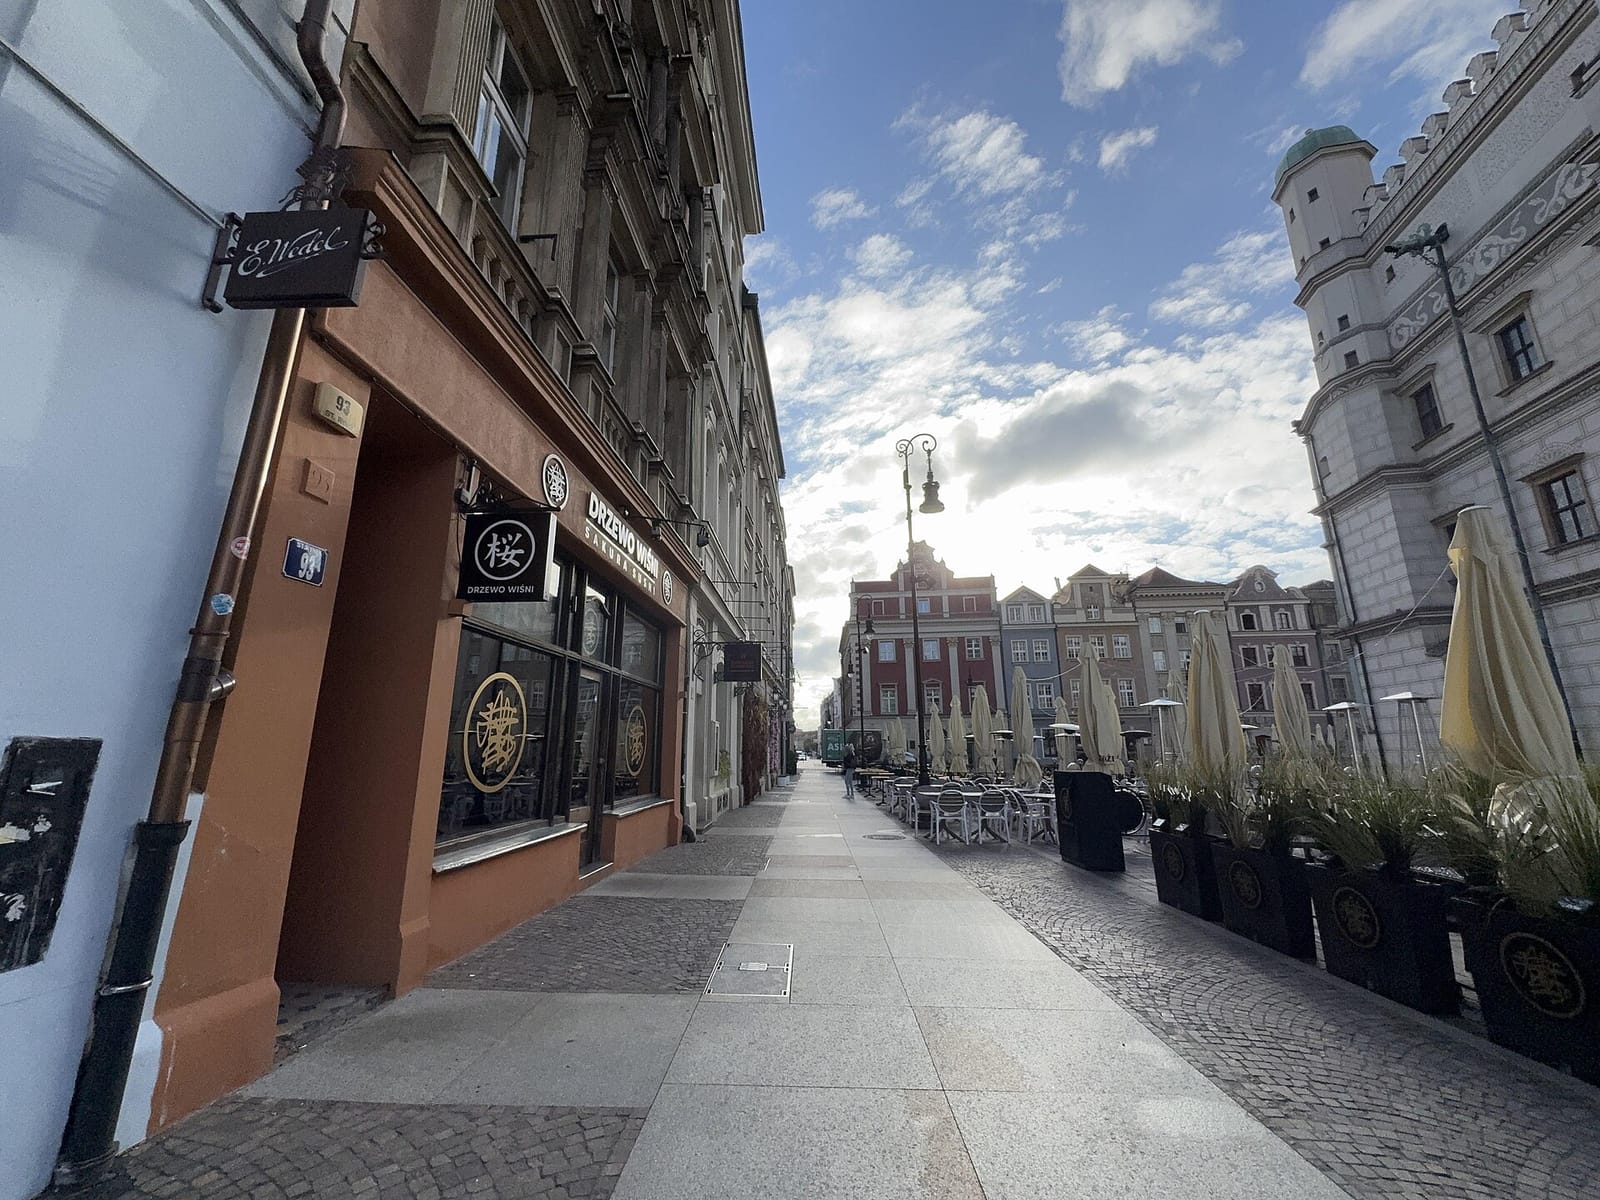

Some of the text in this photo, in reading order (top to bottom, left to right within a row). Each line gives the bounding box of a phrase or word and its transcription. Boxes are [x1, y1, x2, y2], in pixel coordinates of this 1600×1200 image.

[335, 395, 352, 416] 93
[483, 532, 525, 569] 桜
[584, 526, 629, 572] SAKURA
[588, 491, 660, 580] DRZEWO WIŚNI
[298, 552, 316, 580] 93
[466, 583, 535, 594] DRZEWO WIŚNI
